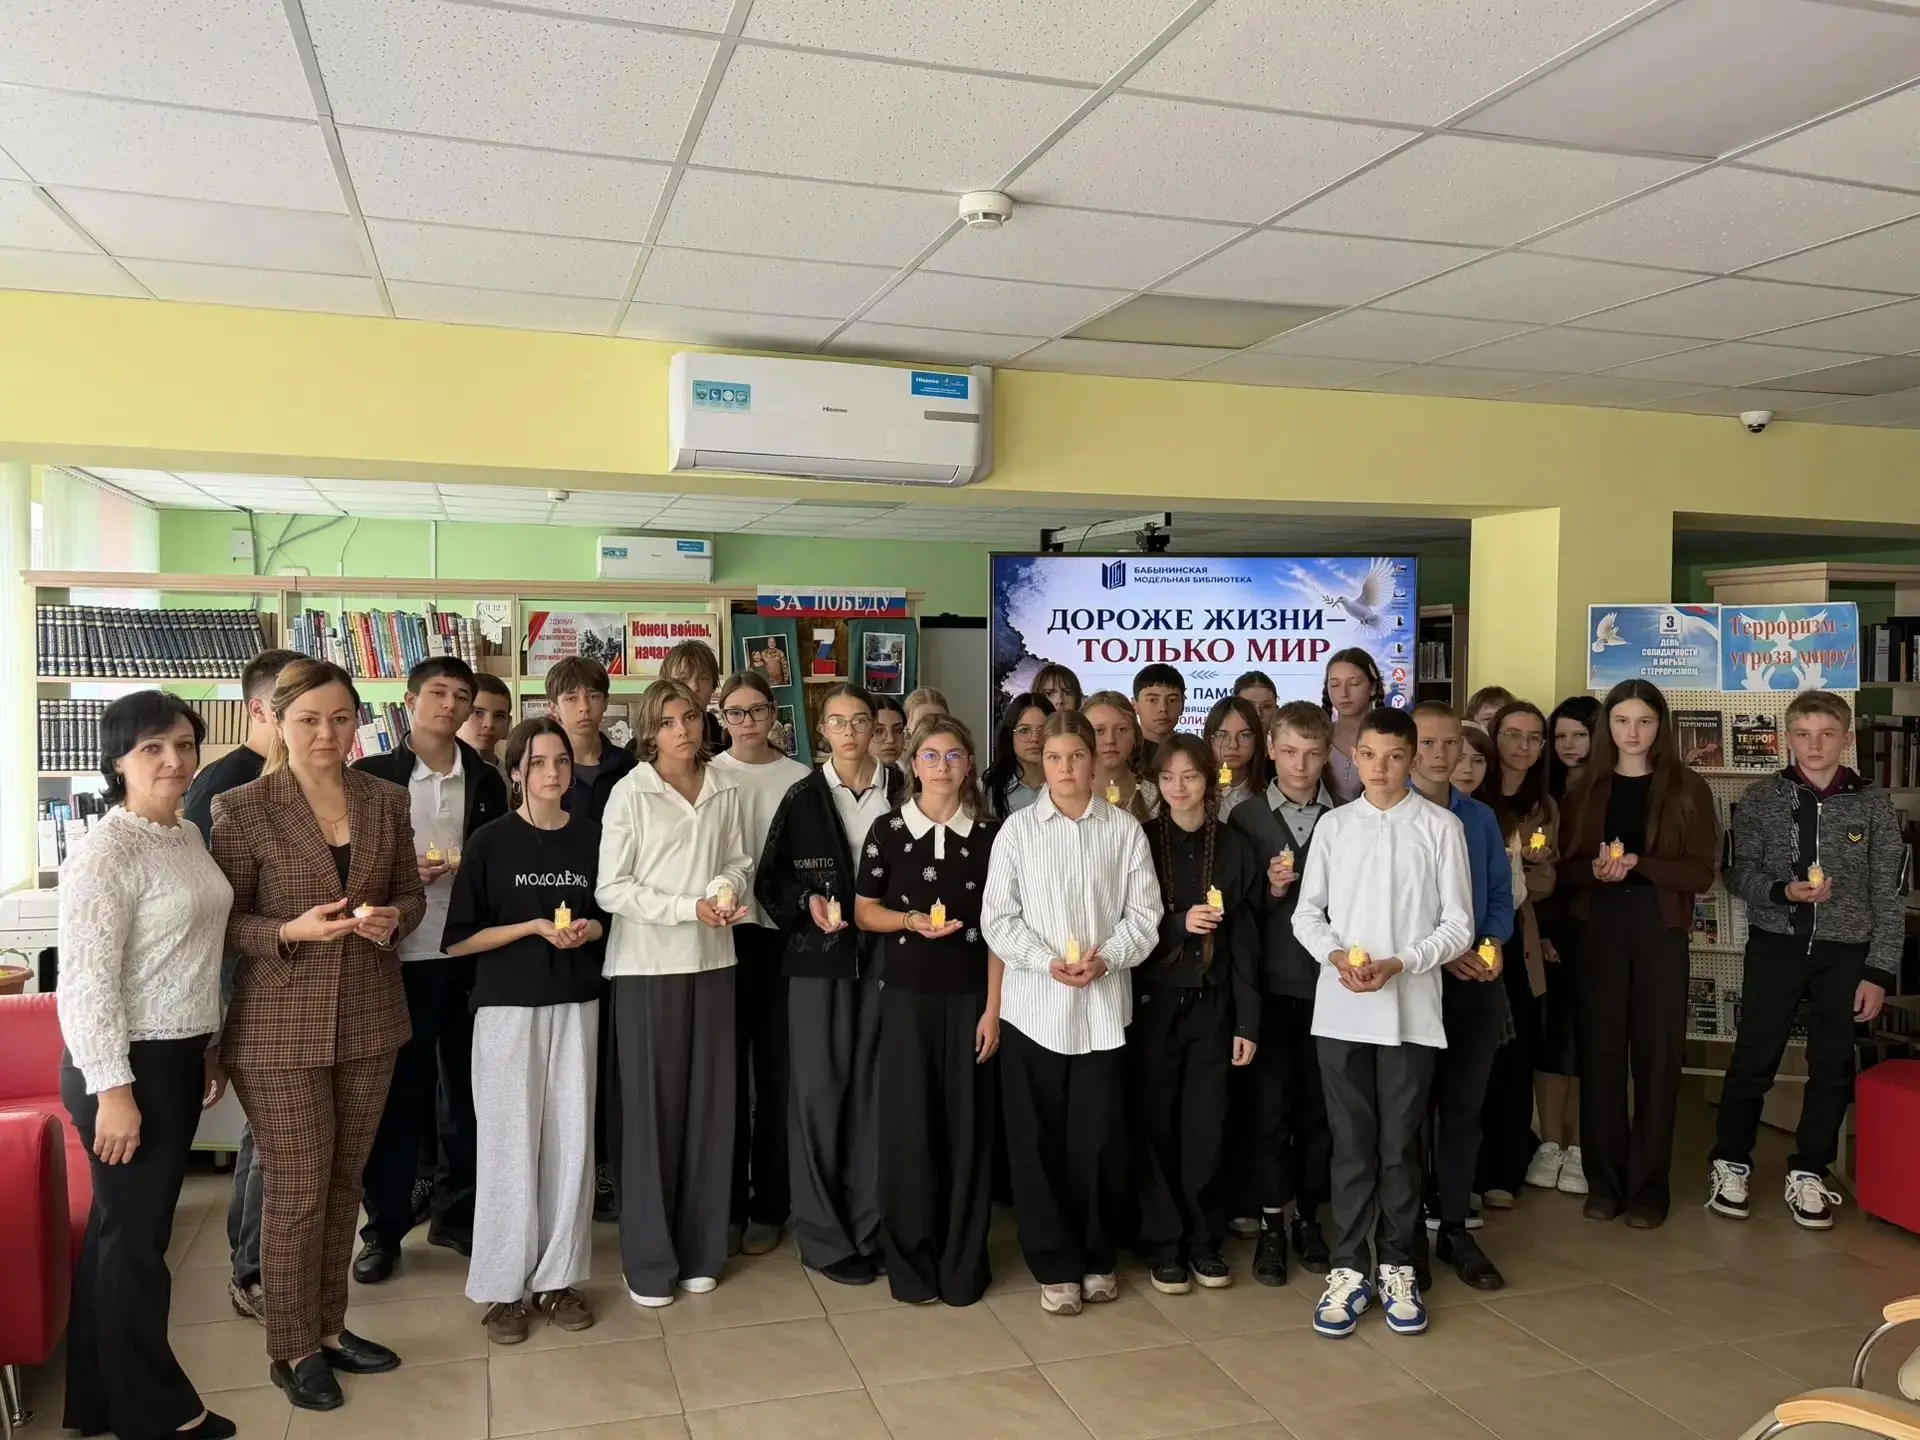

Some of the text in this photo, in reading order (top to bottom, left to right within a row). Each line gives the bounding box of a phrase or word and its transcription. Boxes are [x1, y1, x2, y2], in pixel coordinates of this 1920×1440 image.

[1134, 566, 1208, 574] БАБЫНИНСКАЯ
[1134, 576, 1252, 584] МОДЕЛЬНАЯ БИБЛИОТЕКА
[773, 590, 893, 616] ЗА ПОБЕДУ
[1048, 608, 1193, 634] ДОРОЖЕ
[1666, 615, 1675, 628] 3
[632, 620, 711, 639] Конец войны,
[1730, 617, 1837, 640] Терроризм
[1660, 638, 1680, 647] ДЕНЬ
[635, 646, 673, 660] начал
[1077, 638, 1331, 662] ТОЛЬКО МИР
[1641, 648, 1698, 656] СОЛИДАРНОСТИ
[1653, 658, 1686, 666] В БОРЬБЕ
[1731, 649, 1792, 672] угроза
[1641, 667, 1698, 675] С ТЕРРОРИЗМОМ
[1736, 733, 1775, 744] ТЕРРОР
